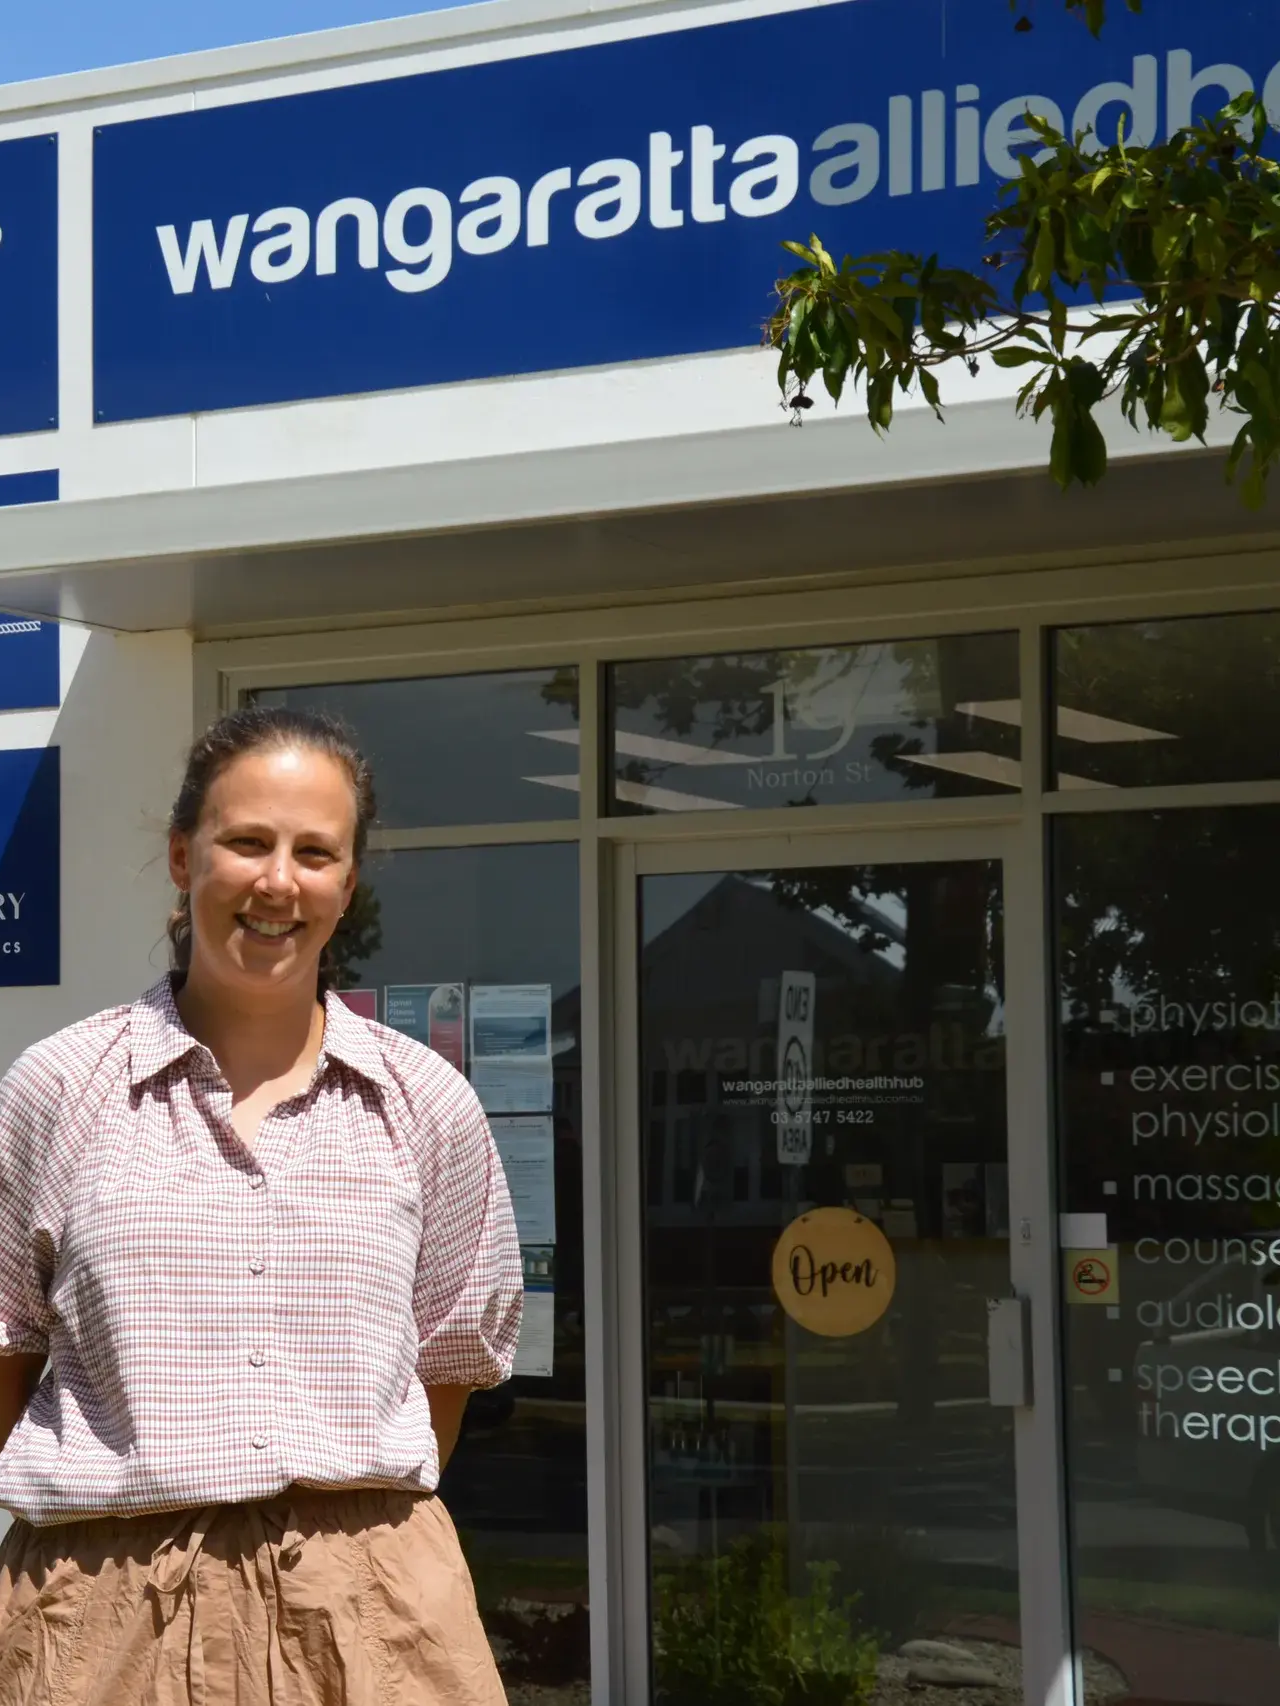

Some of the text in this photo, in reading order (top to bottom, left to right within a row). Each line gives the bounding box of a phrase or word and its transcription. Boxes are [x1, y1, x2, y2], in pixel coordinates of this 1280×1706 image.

[747, 760, 873, 790] Norton St
[722, 1075, 924, 1095] wangarattaalliedhealthhub
[770, 1109, 875, 1124] 03 5747 5422
[789, 1244, 879, 1298] Open
[1136, 1293, 1280, 1330] audiol
[1137, 1359, 1280, 1400] speec
